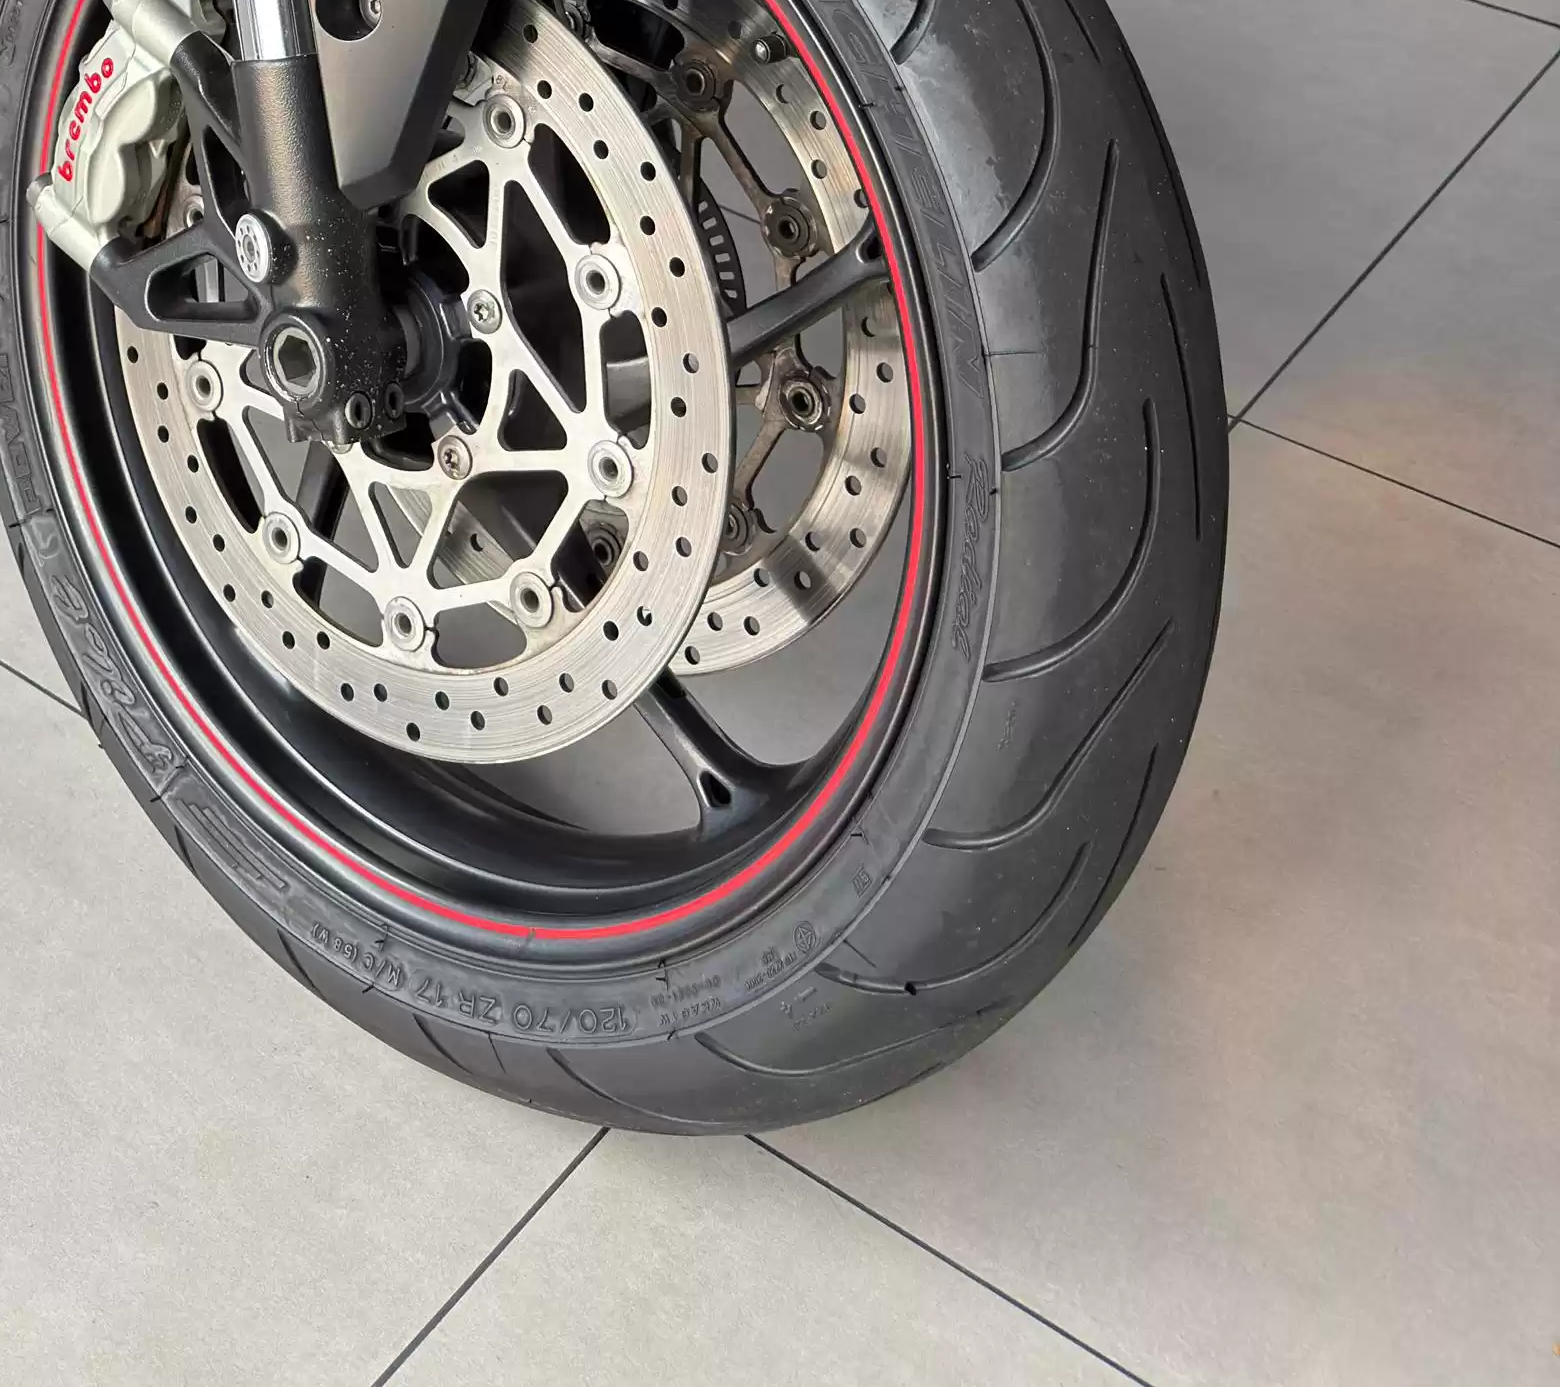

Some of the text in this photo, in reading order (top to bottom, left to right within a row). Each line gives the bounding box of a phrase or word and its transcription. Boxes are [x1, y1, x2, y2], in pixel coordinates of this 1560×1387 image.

[57, 57, 114, 182] brembo
[416, 976, 443, 1008] 17
[456, 990, 498, 1025] ZR
